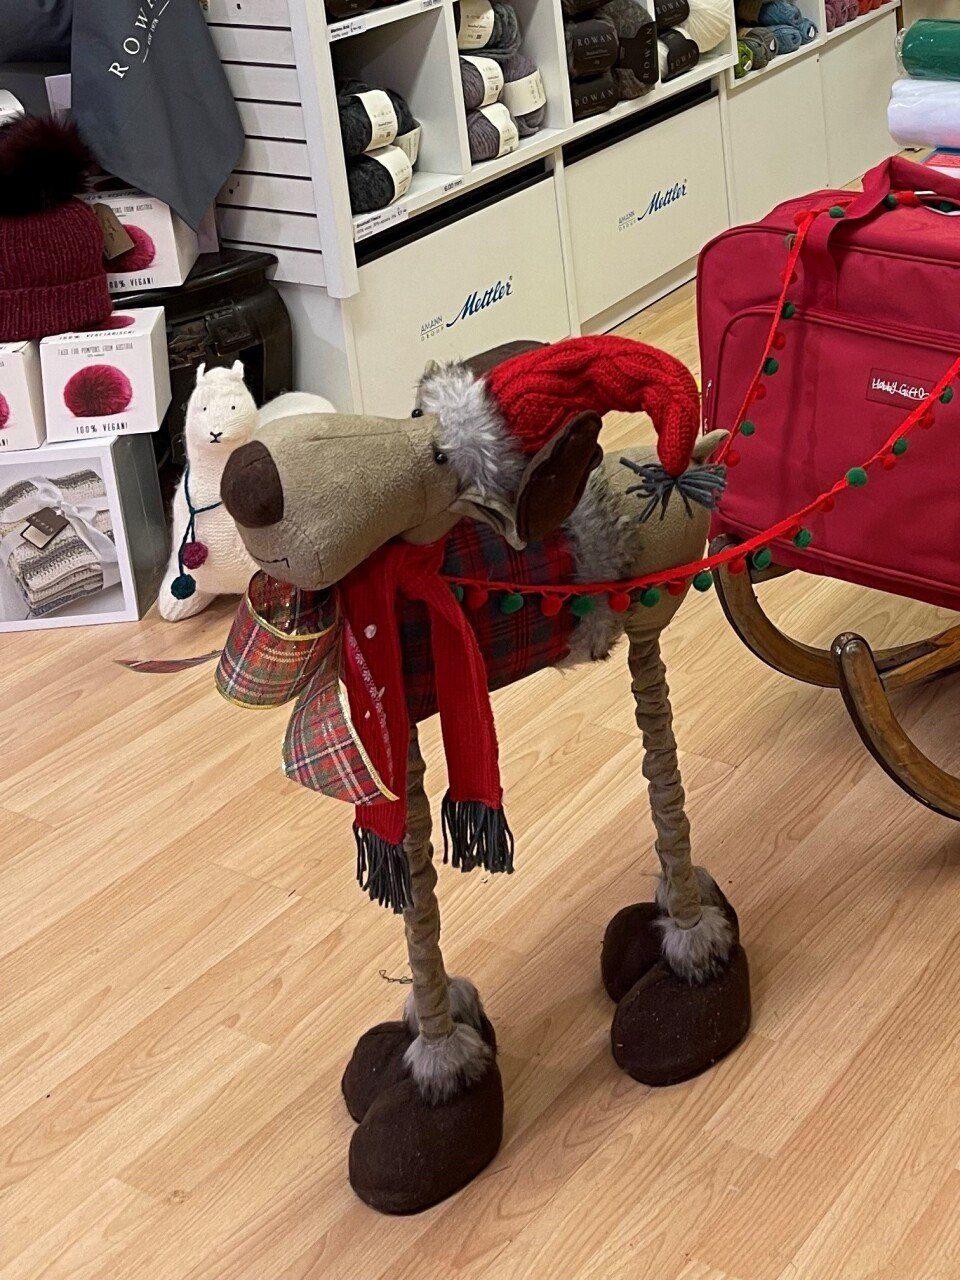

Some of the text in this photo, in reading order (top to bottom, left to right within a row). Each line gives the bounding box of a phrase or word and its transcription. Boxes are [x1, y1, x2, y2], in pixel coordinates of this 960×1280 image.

[577, 34, 613, 46] ROWAN
[574, 89, 615, 108] ROWAN
[637, 182, 687, 221] Mettler
[446, 280, 513, 327] Mettler
[421, 315, 443, 335] AMANN
[421, 327, 445, 342] GROUP
[76, 422, 128, 434] 100% VEGAN!
